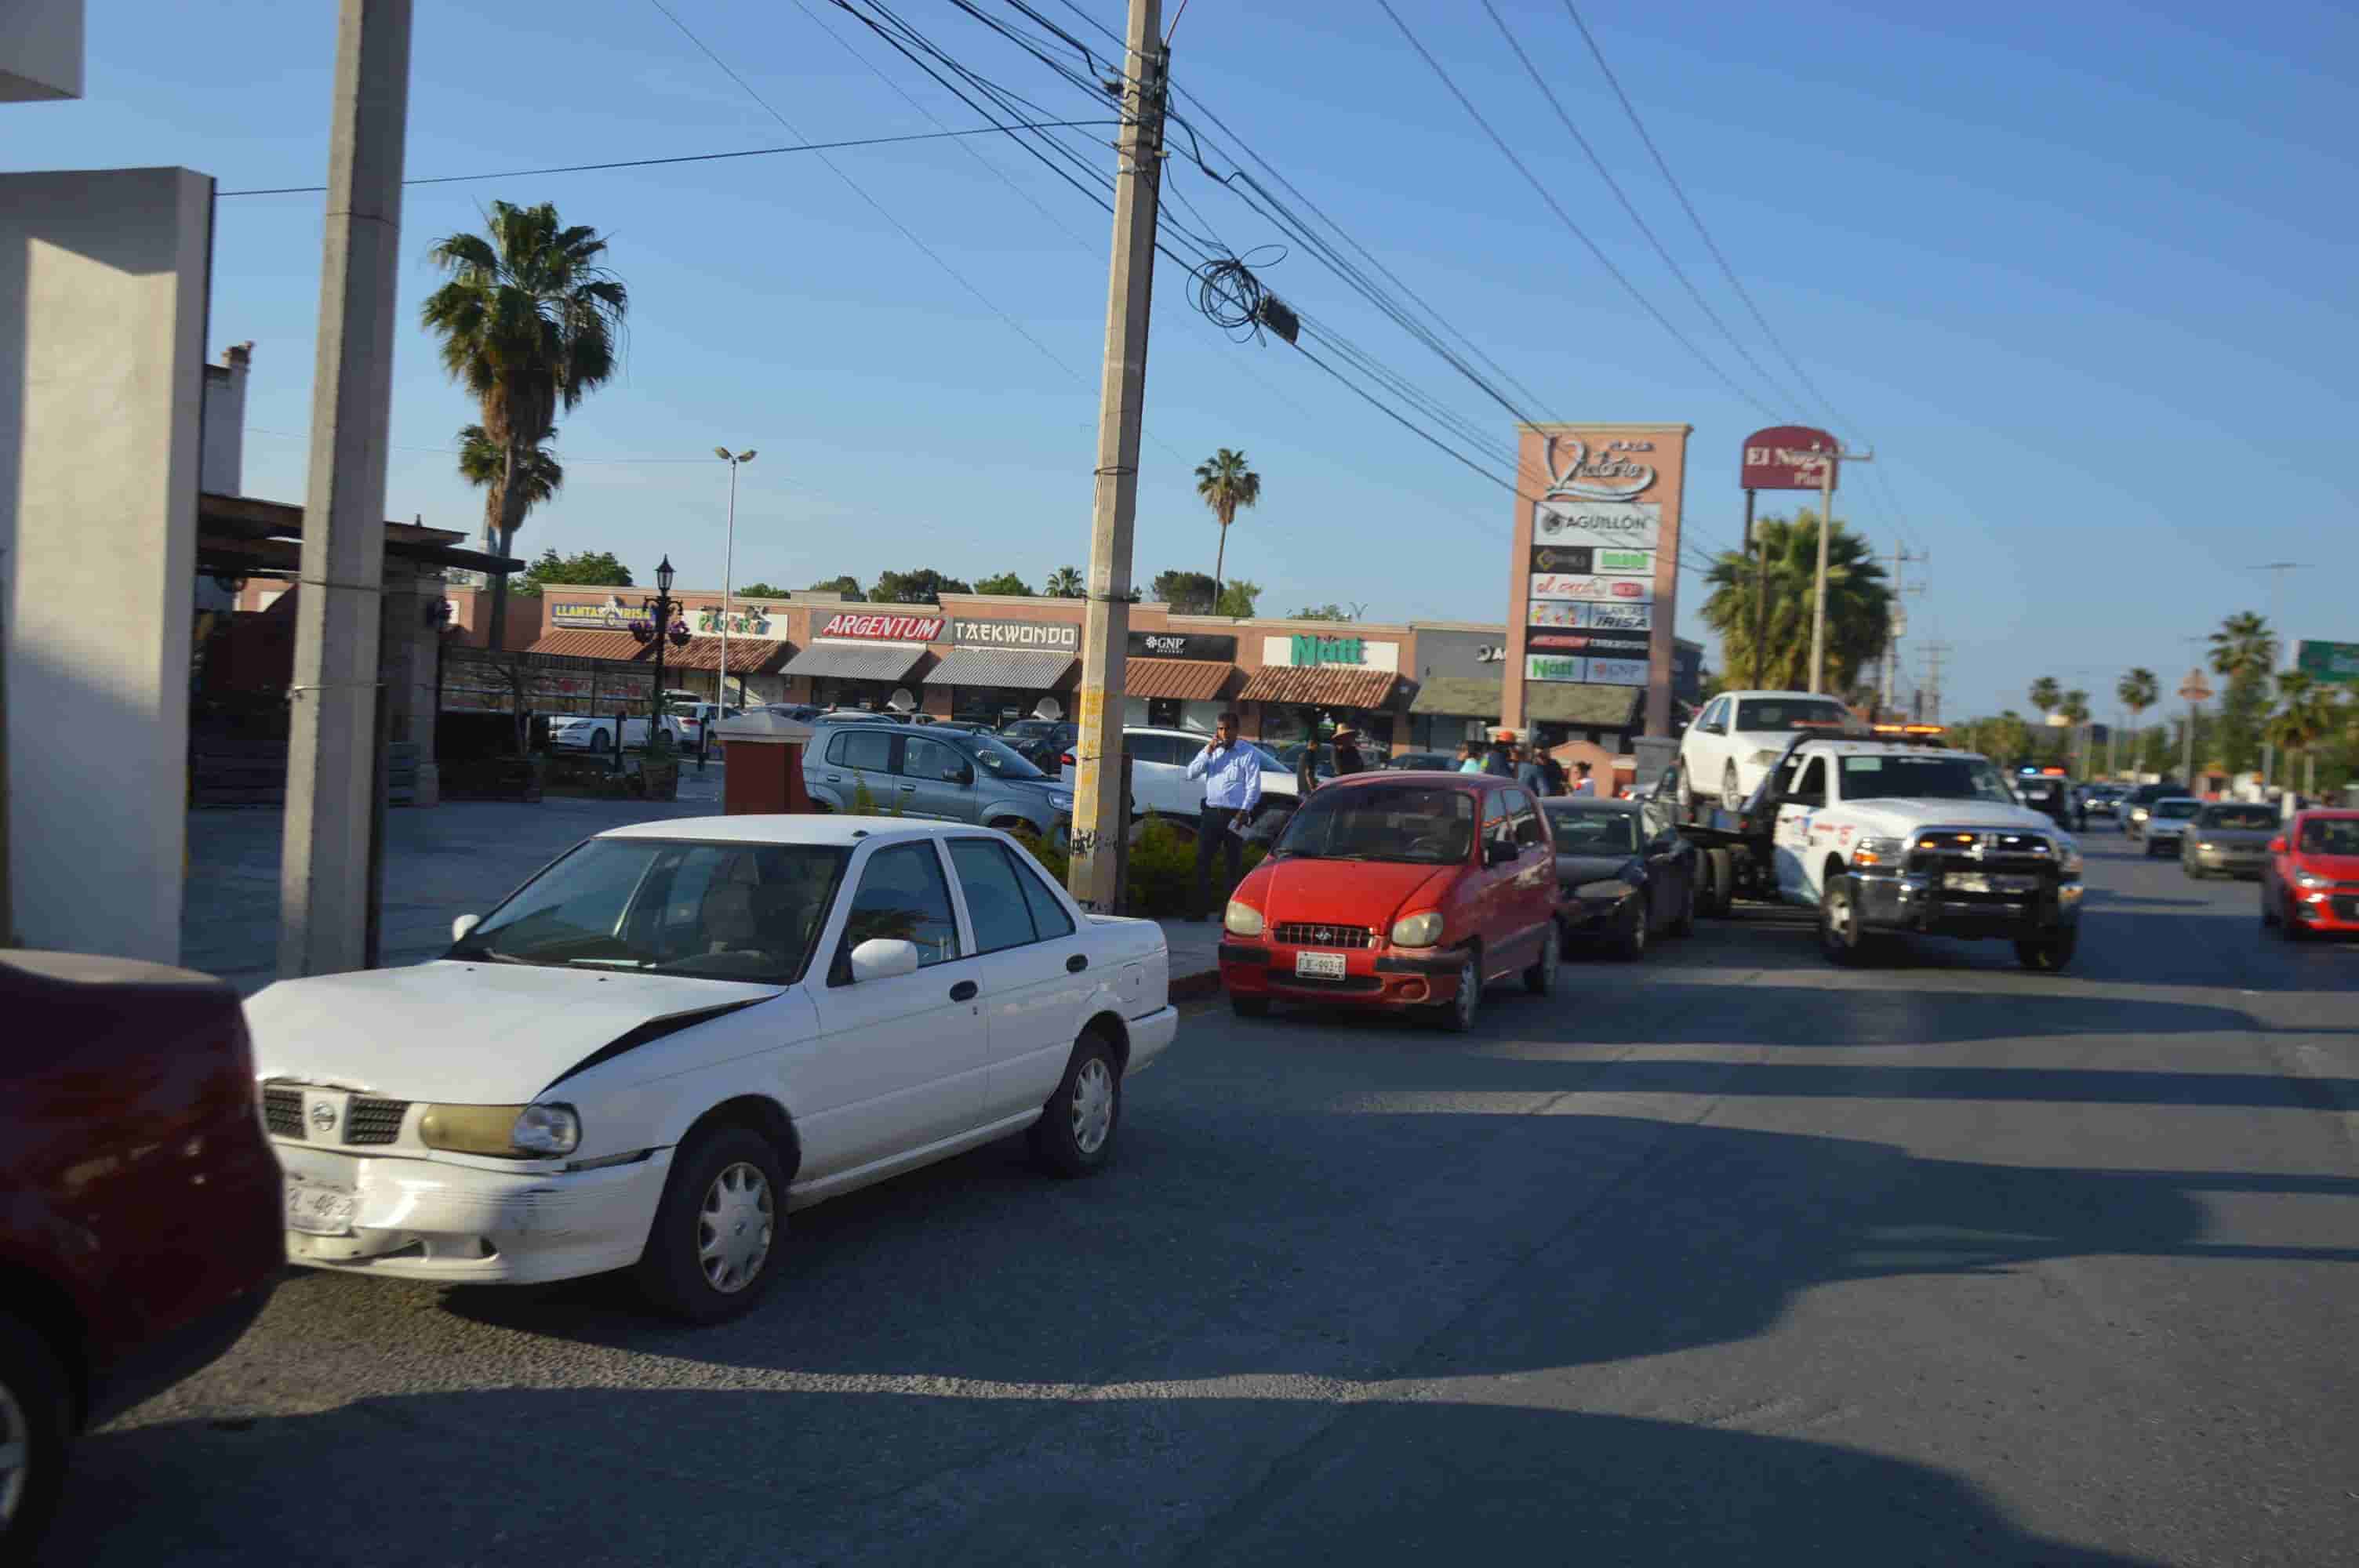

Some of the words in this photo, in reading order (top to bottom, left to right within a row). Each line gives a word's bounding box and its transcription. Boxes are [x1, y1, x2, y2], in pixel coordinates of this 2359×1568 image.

[823, 614, 945, 640] ARGENTUM
[954, 622, 1074, 645] TAEKWONDO
[1158, 637, 1187, 649] GNP
